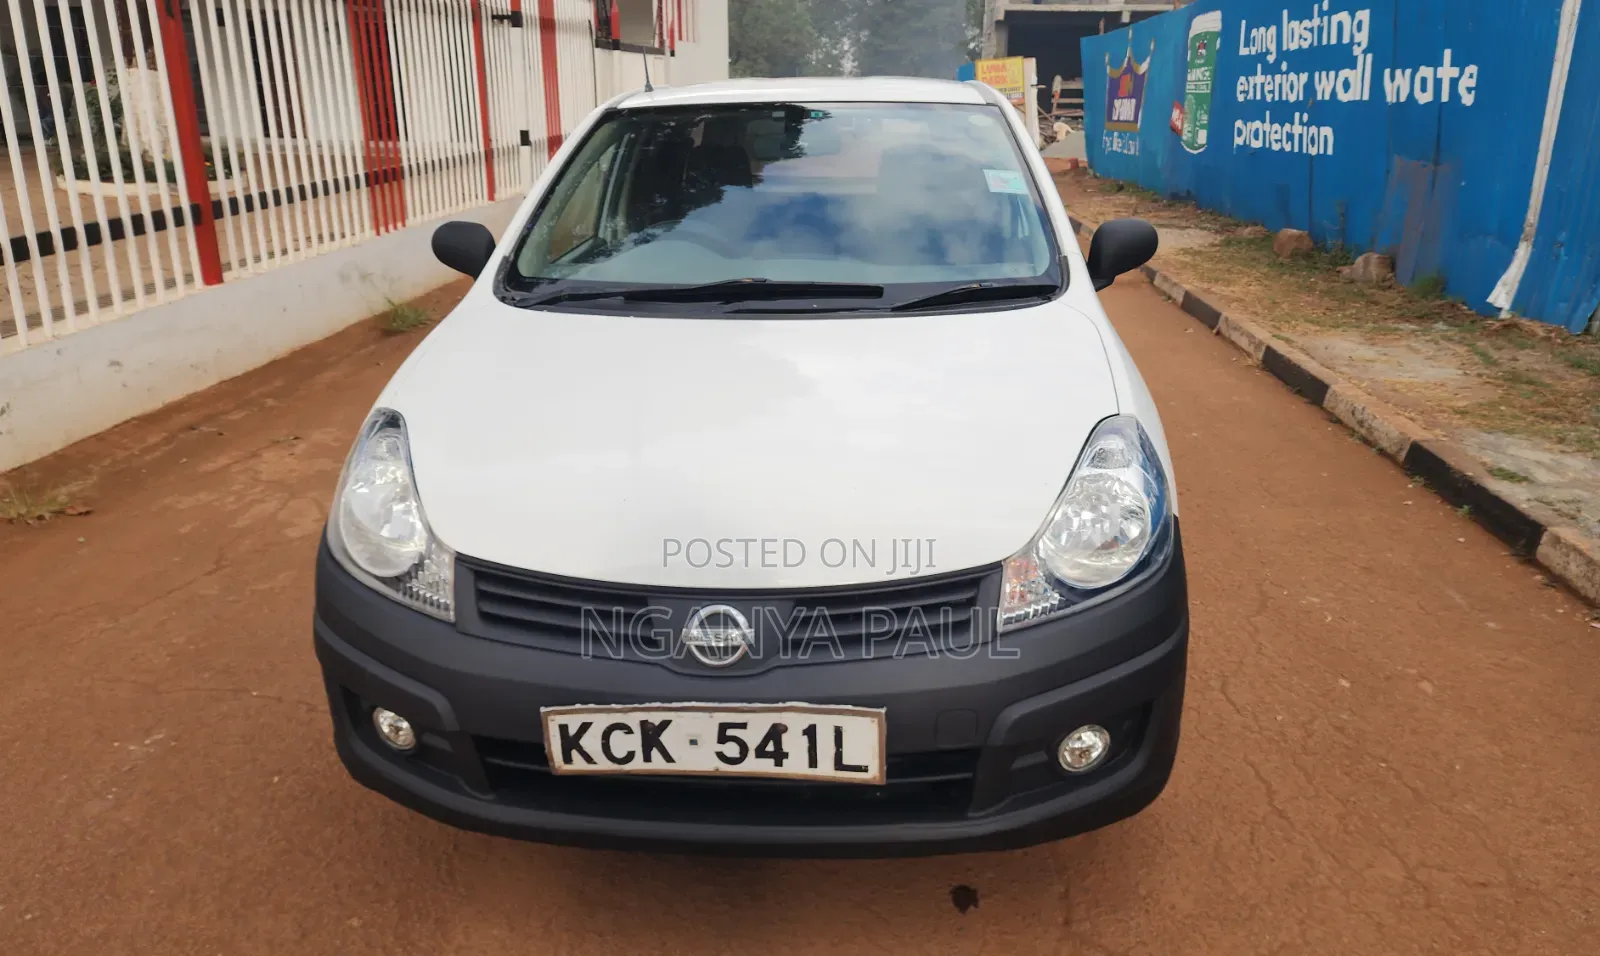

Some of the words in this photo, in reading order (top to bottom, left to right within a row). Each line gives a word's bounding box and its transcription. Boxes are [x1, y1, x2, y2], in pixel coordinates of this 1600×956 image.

[1238, 19, 1277, 64] Long
[1282, 0, 1371, 56] lasting
[1236, 60, 1309, 102] exterior
[1314, 53, 1373, 102] wall
[1383, 48, 1479, 107] wate
[1233, 110, 1334, 156] protection
[558, 719, 676, 765] KCK
[714, 722, 869, 773] 541L
